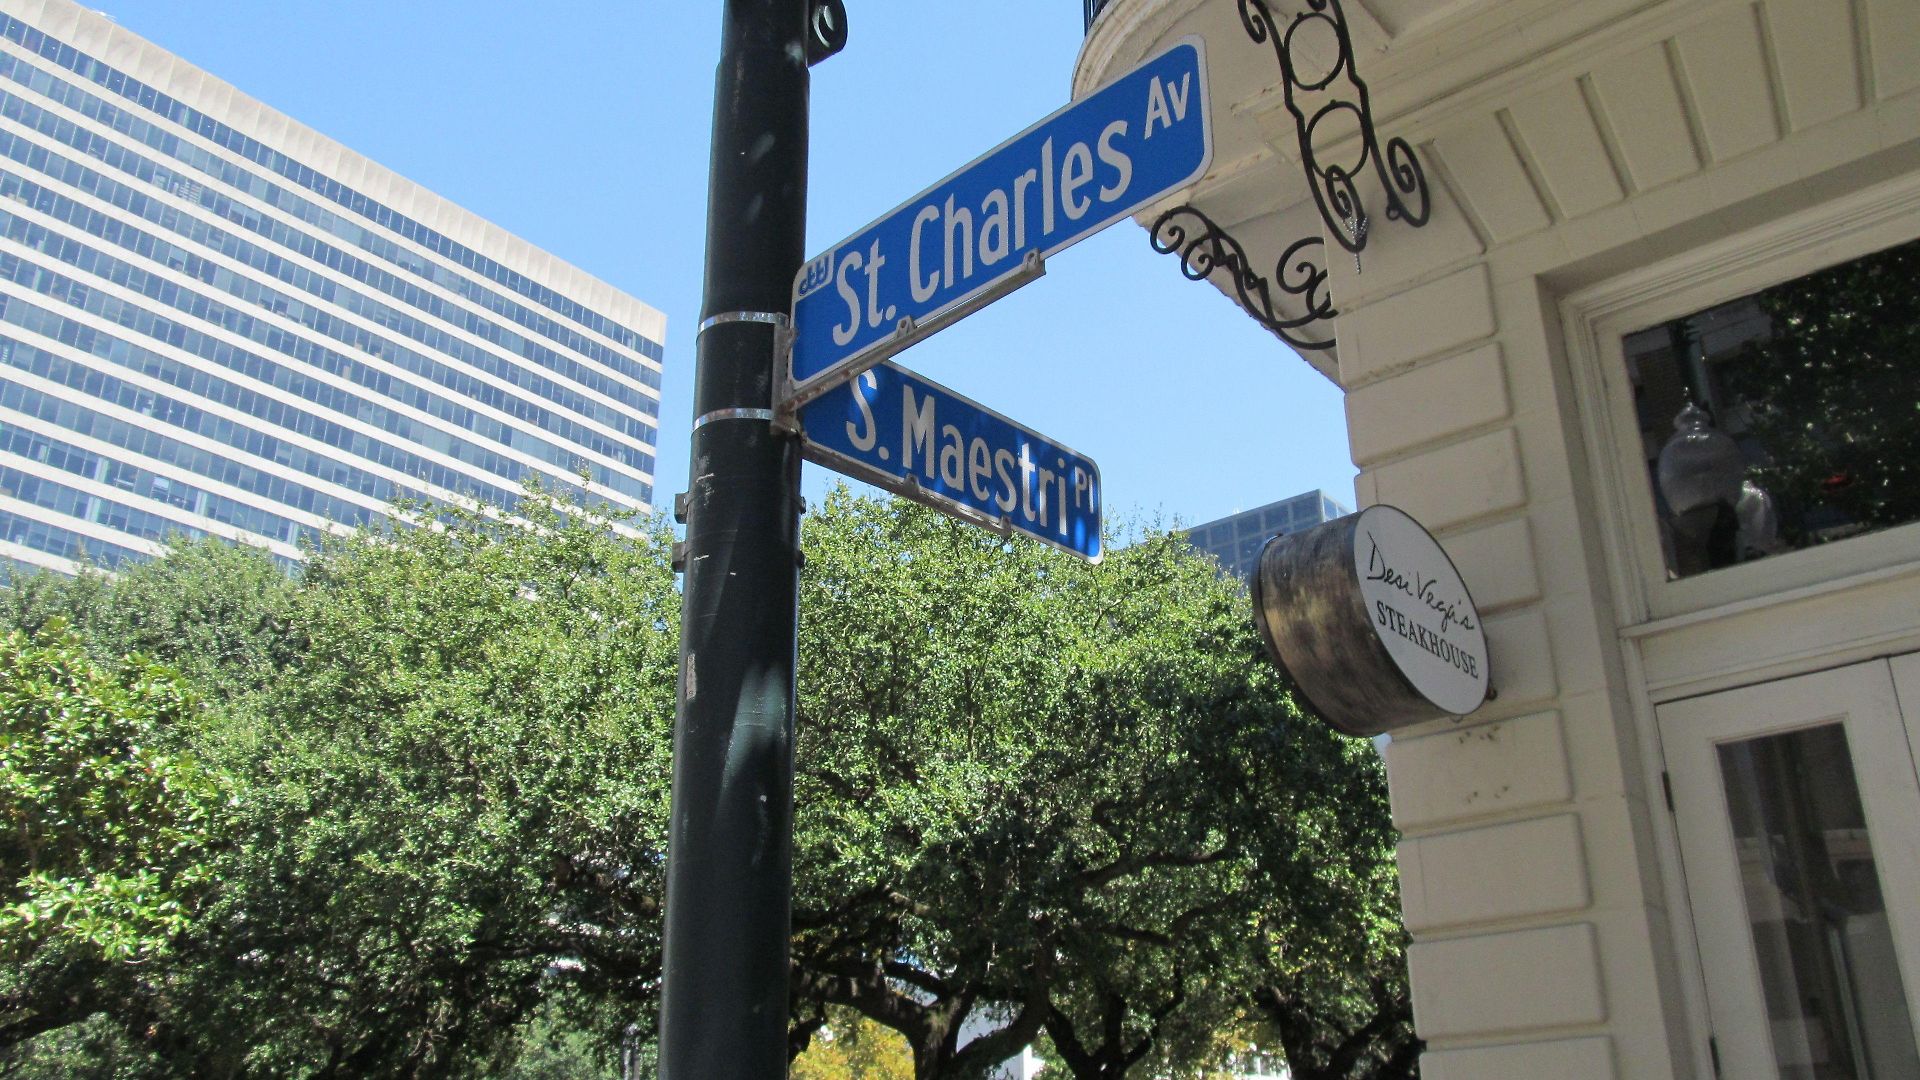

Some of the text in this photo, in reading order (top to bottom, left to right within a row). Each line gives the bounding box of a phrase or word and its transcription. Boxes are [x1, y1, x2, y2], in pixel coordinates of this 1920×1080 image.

[832, 71, 1190, 346] St. Charles Av
[845, 368, 1095, 536] S. Maestri Pl
[1366, 531, 1413, 597] Desi
[1376, 600, 1479, 680] STEAKHOUSE
